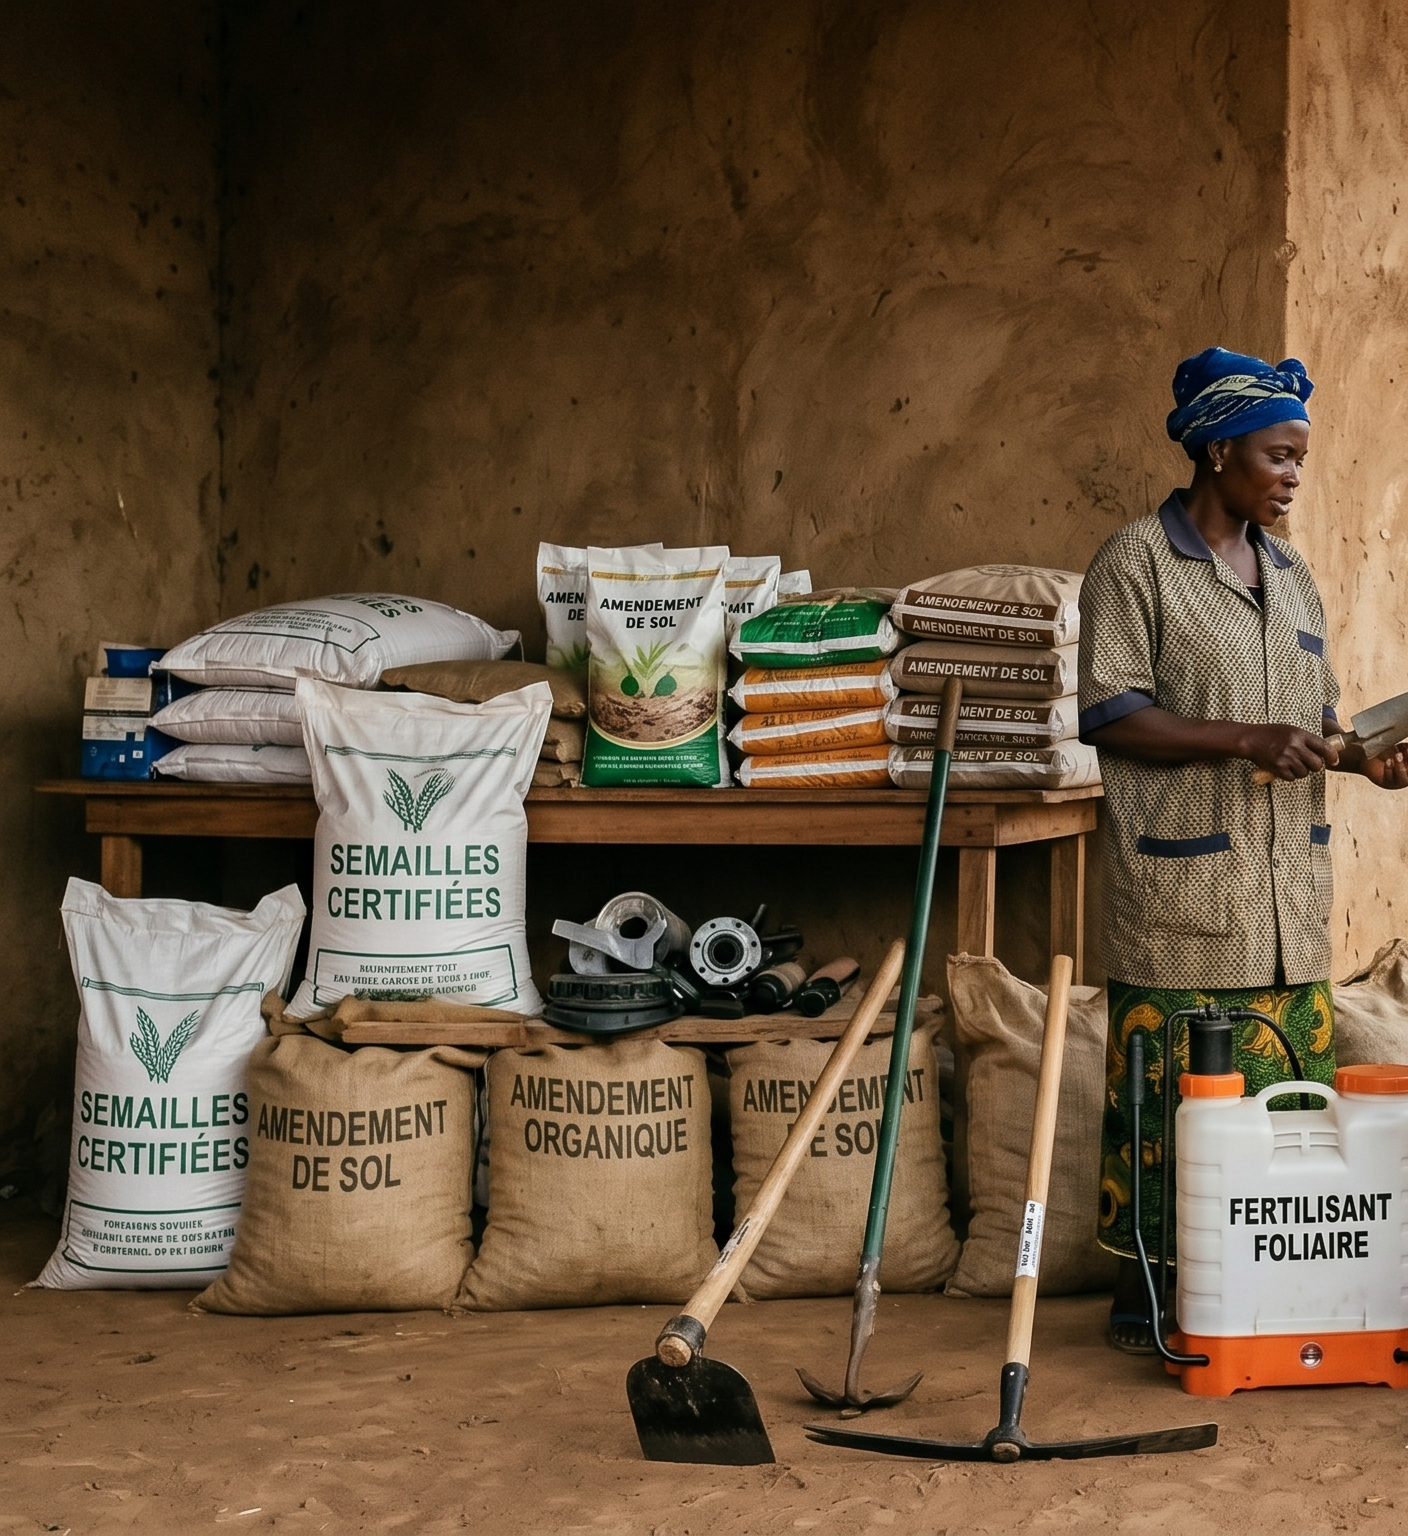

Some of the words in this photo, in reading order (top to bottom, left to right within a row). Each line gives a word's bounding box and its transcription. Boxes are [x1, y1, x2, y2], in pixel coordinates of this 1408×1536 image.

[568, 609, 585, 621] DE
[600, 596, 704, 612] AMENDEMENT
[1002, 604, 1019, 615] DE
[1021, 606, 1044, 618] SOL
[625, 617, 645, 629] DE
[650, 616, 677, 629] SOL
[999, 629, 1016, 641] DE
[1018, 631, 1043, 643] SOL
[908, 661, 998, 678] AMENDEMENT
[1001, 667, 1019, 680] DE
[1022, 668, 1048, 681] SOL
[910, 704, 994, 719] AMEMENT
[995, 708, 1012, 719] DE
[1014, 709, 1038, 721] SOL
[995, 751, 1012, 761] DE
[1014, 751, 1040, 762] SOL
[330, 844, 500, 876] SEMAILLES
[327, 880, 501, 920] CERTIFIÉES
[80, 1090, 249, 1129] SEMAILLES
[510, 1074, 694, 1115] AMENDEMENT
[258, 1100, 447, 1146] AMENDEMENT
[524, 1117, 688, 1159] ORGANIQUE
[78, 1132, 249, 1175] CERTIFIÉES
[787, 1123, 828, 1157] E
[292, 1154, 330, 1192] DE
[339, 1153, 401, 1192] SOL
[1230, 1193, 1392, 1225] FERTILISANT
[1254, 1231, 1369, 1262] FOLIAIRE
